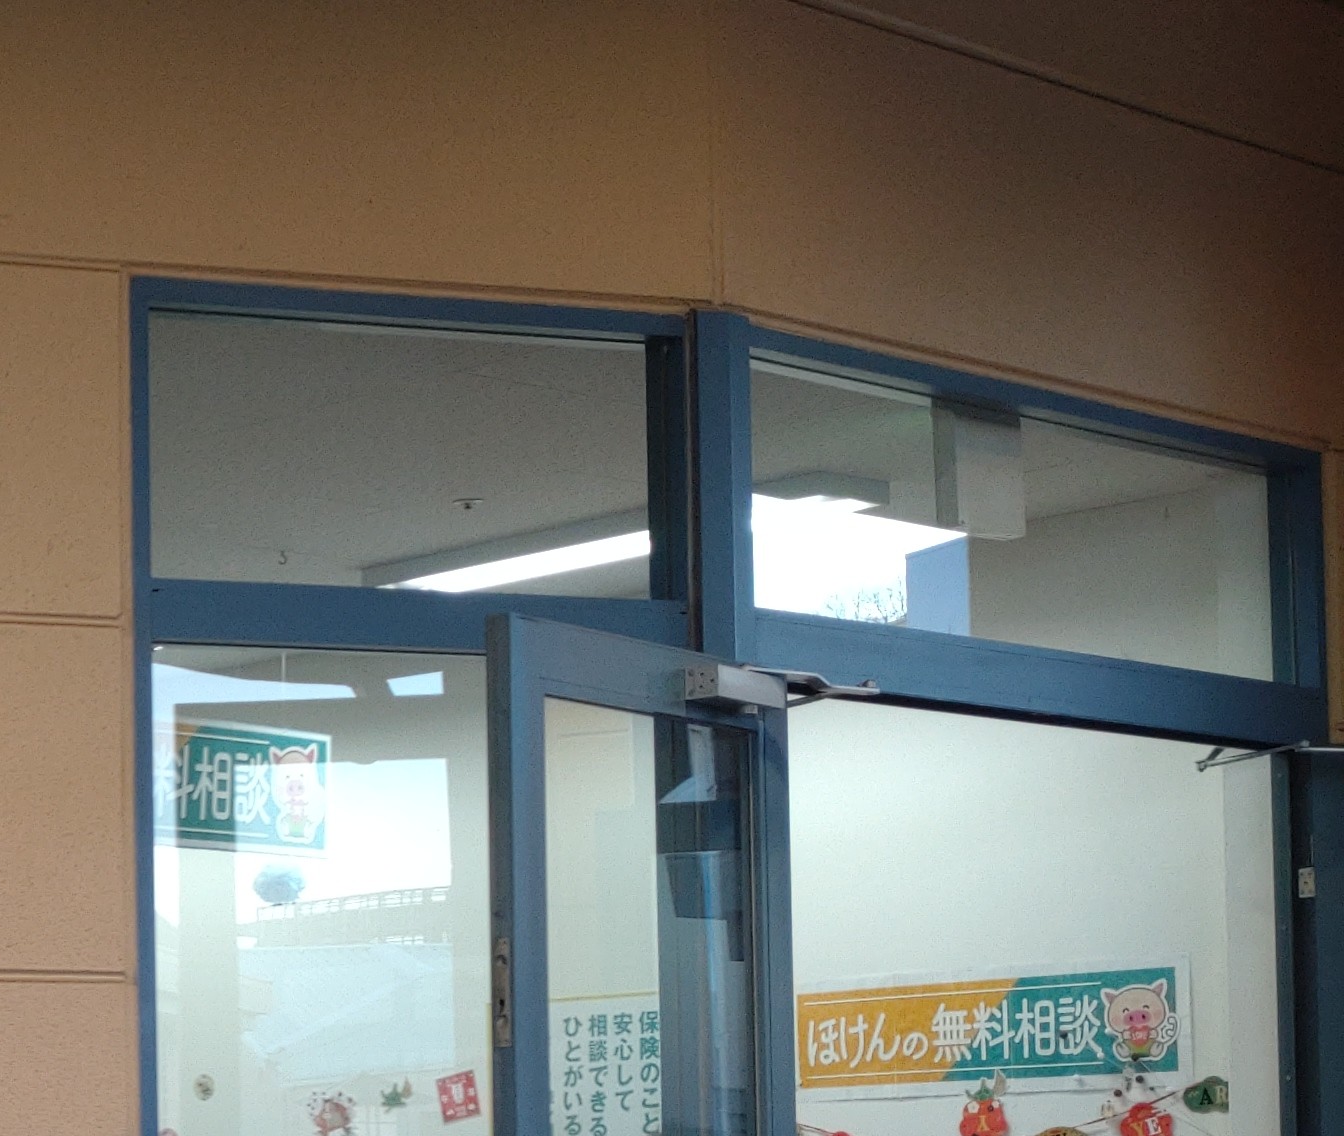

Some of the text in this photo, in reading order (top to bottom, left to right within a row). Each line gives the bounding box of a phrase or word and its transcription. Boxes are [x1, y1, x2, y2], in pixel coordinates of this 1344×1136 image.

[612, 1012, 633, 1112] 安心して
[638, 1011, 661, 1135] 保険のこと
[807, 995, 1103, 1069] ほけんの無料相談
